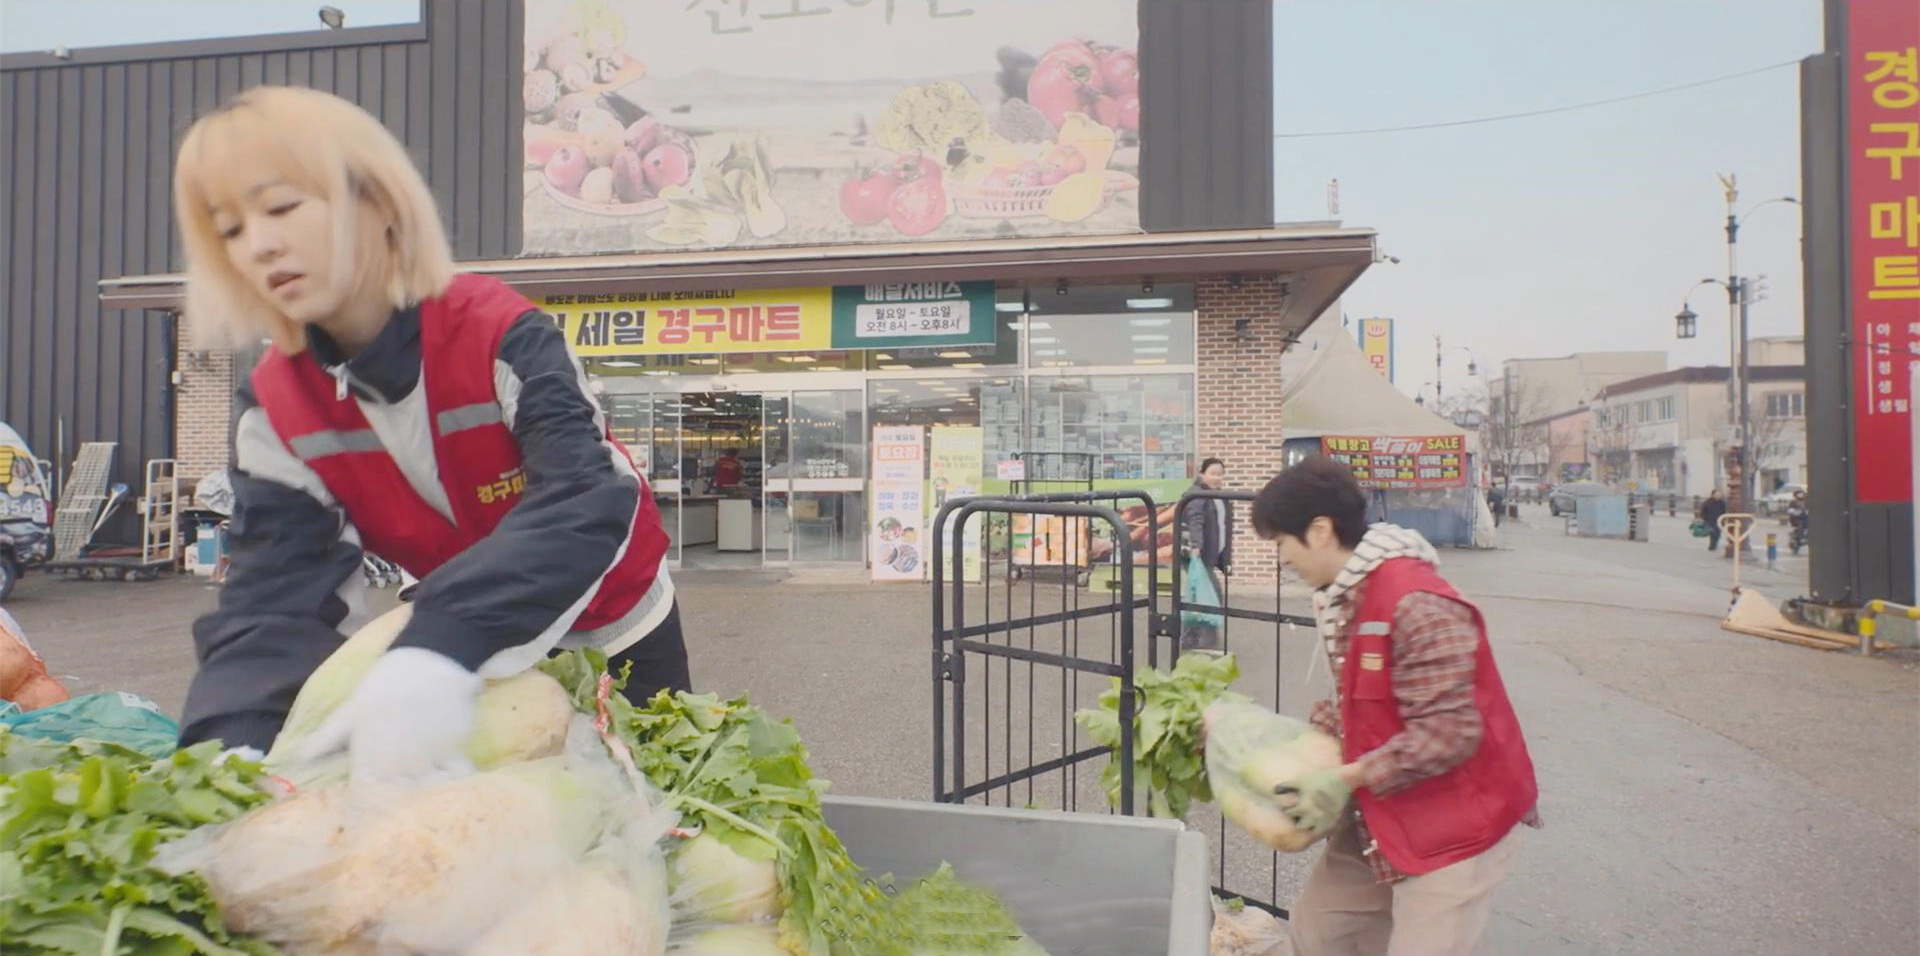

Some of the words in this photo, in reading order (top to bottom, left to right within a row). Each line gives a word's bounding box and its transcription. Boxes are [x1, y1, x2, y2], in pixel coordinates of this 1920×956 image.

[1864, 47, 1920, 299] 경구마트
[865, 281, 962, 301] 배달서비스
[875, 307, 907, 321] 월요일
[919, 305, 952, 319] 토요일
[575, 310, 646, 347] 세일
[656, 306, 801, 345] 경구마트
[866, 321, 887, 333] 오전
[889, 320, 908, 332] 8시
[1426, 436, 1459, 450] SALE
